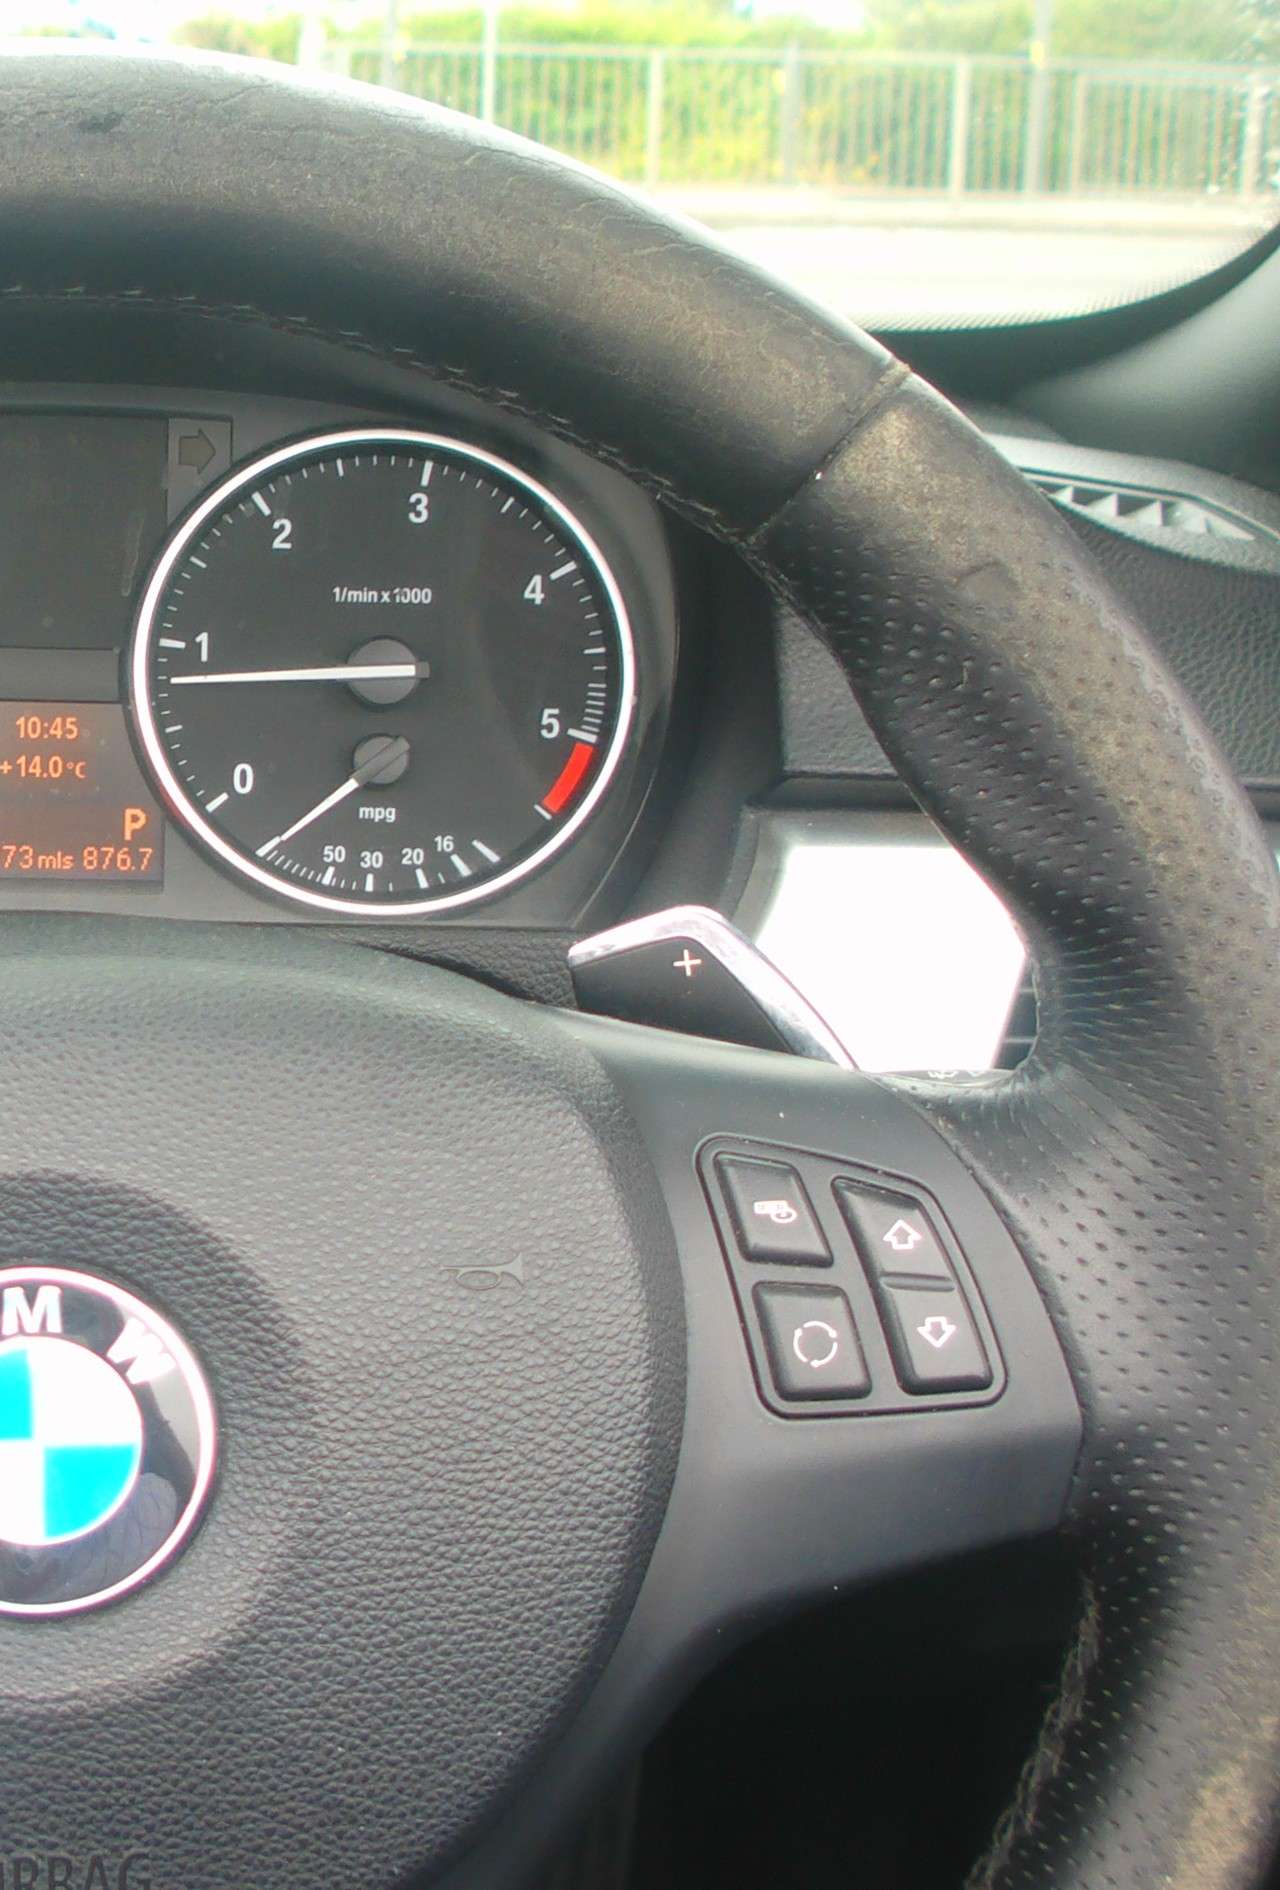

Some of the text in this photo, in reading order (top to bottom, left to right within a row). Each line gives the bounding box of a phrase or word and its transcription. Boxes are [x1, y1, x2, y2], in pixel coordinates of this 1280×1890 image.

[408, 493, 429, 524] 3
[272, 518, 292, 549] 2
[332, 586, 432, 604] 1/min x 1000
[523, 575, 545, 605] 4
[195, 632, 209, 662] 1
[16, 715, 78, 739] 10:45
[540, 708, 560, 739] 5
[233, 763, 254, 794] 0
[123, 808, 147, 841] P
[359, 805, 396, 823] mpg
[323, 845, 346, 863] 50
[401, 847, 425, 865] 20
[434, 835, 454, 853] 16
[83, 847, 153, 871] 876.7
[360, 851, 384, 869] 30
